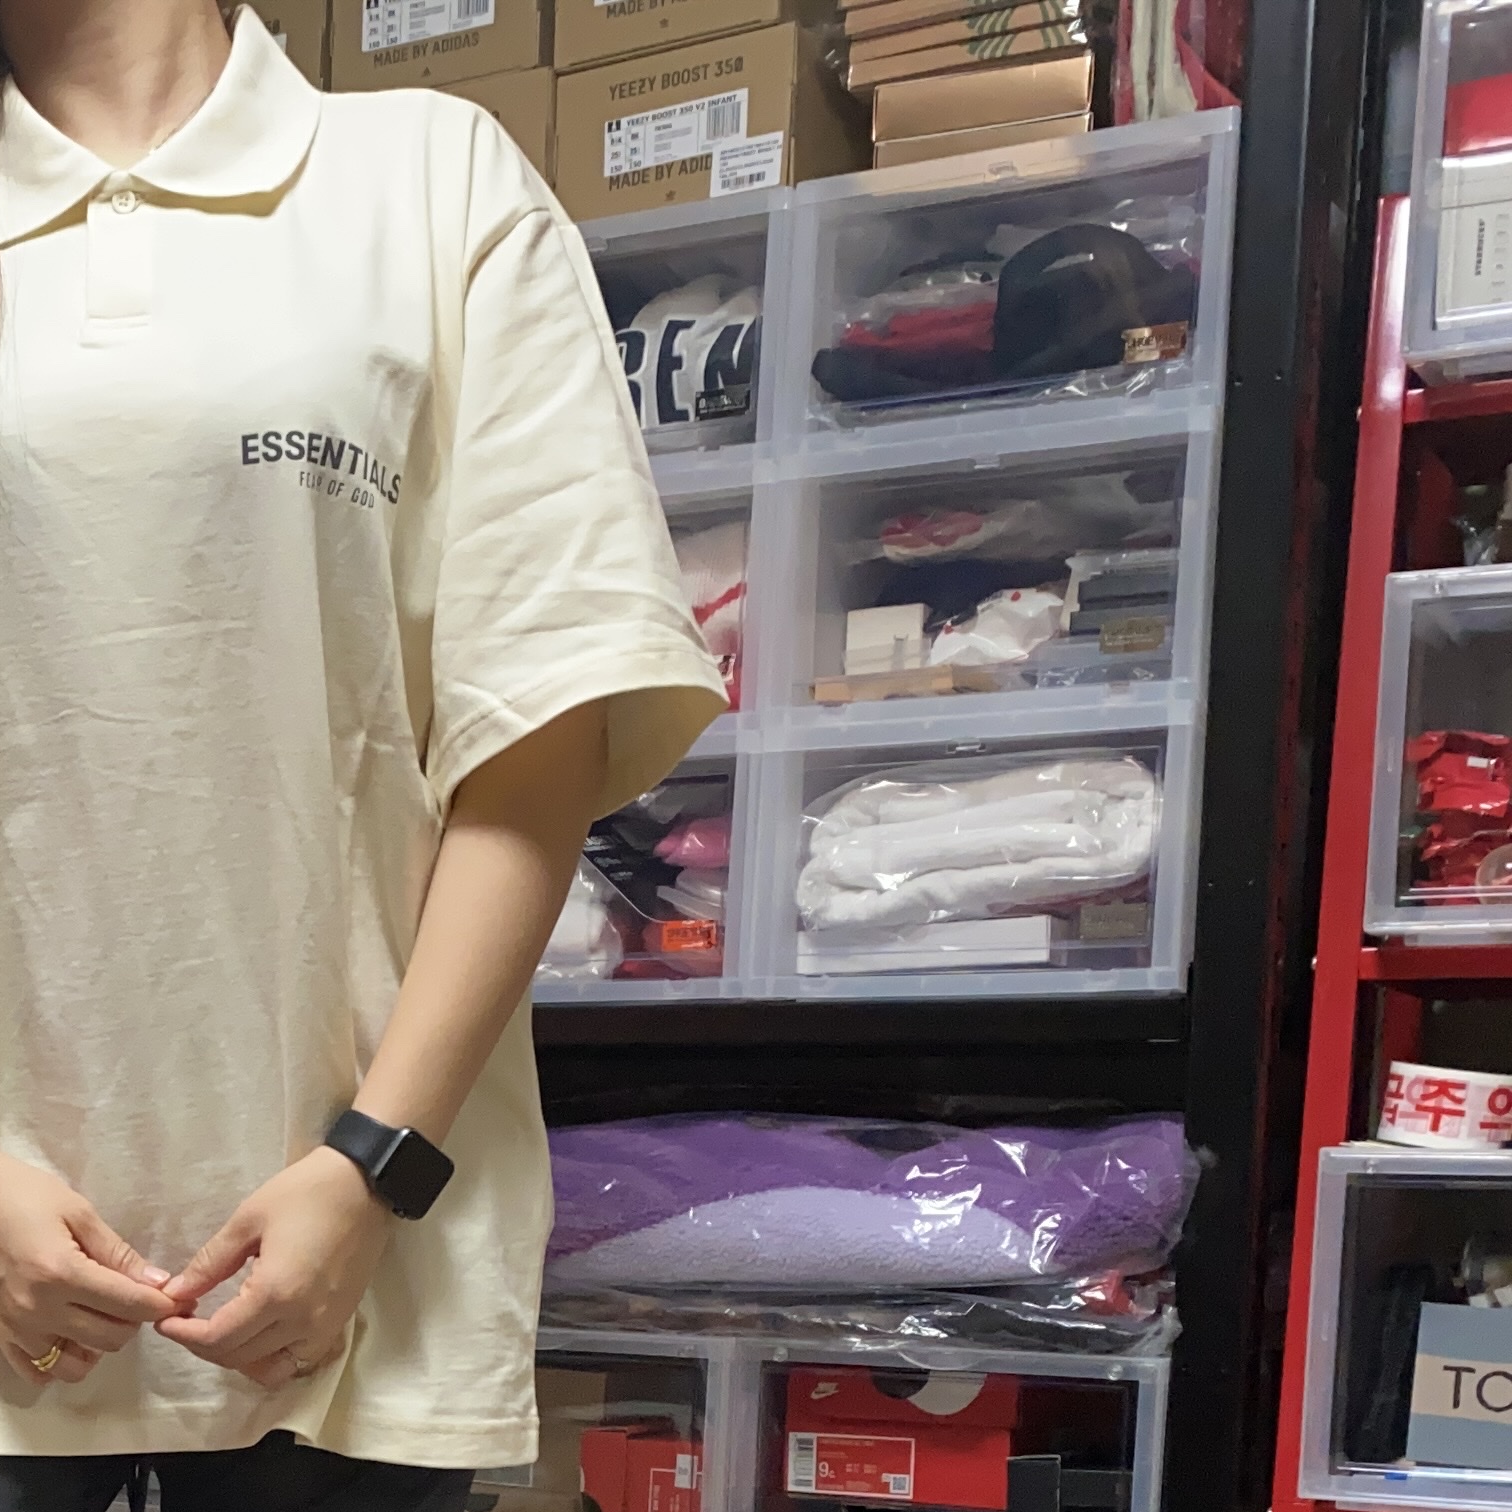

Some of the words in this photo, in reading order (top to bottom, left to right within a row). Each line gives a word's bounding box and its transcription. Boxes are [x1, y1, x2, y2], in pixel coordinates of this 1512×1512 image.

[373, 50, 408, 68] MADE
[412, 43, 428, 60] BY
[432, 32, 480, 56] ADIDAS
[609, 76, 656, 100] YEEZY
[662, 64, 710, 90] BOOST
[714, 56, 744, 78] 350
[626, 116, 650, 126] YEEZY
[652, 109, 677, 120] BOOST
[708, 94, 738, 108] INFANT
[609, 173, 650, 192] MADE
[655, 164, 674, 180] BY
[242, 430, 401, 504] ESSENTIALS
[300, 472, 322, 492] FEAR
[328, 480, 344, 496] OF
[351, 487, 374, 508] GOD
